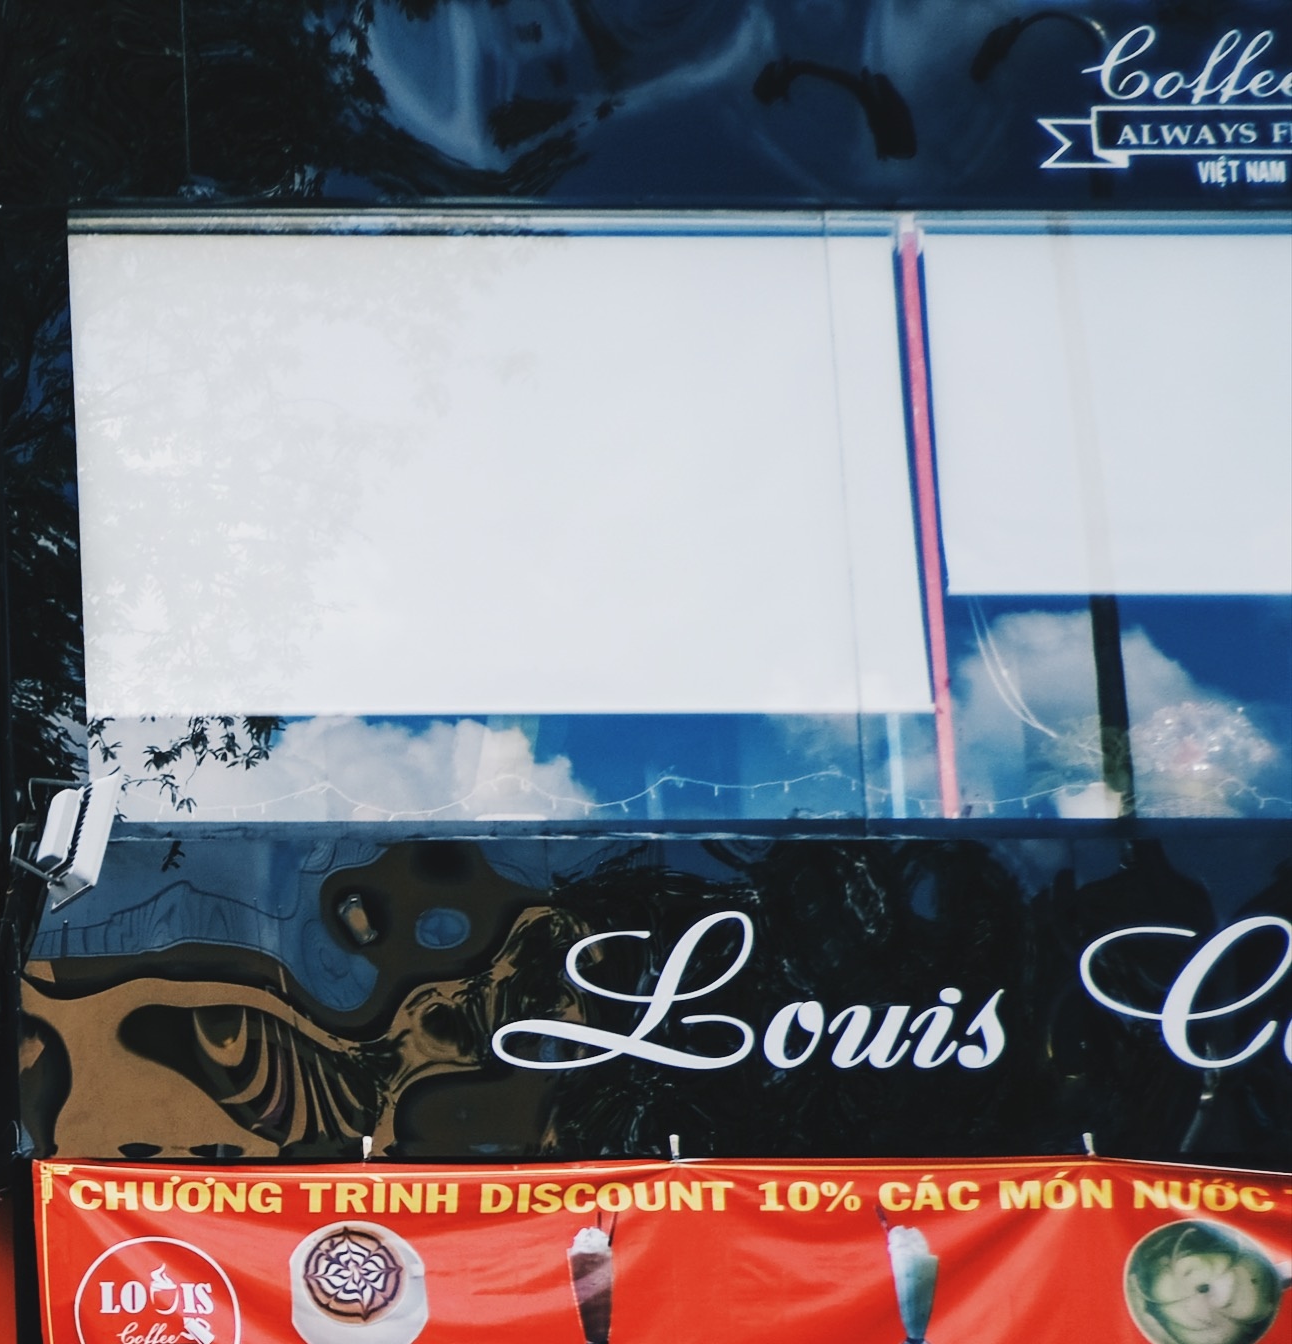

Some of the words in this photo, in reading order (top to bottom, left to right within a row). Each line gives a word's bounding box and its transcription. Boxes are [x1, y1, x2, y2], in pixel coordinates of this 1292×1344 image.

[1116, 123, 1258, 145] ALWAYS
[1197, 156, 1241, 187] VIỆT
[1245, 160, 1288, 183] NAM
[490, 910, 1006, 1071] Louis
[68, 1175, 287, 1213] CHƯƠNG
[298, 1176, 460, 1214] TRÌNH
[479, 1179, 734, 1213] DISCOUNT
[758, 1180, 862, 1211] 10%
[878, 1174, 981, 1211] CÁC
[998, 1171, 1114, 1210] MÓN
[1132, 1178, 1277, 1213] NƯỚC
